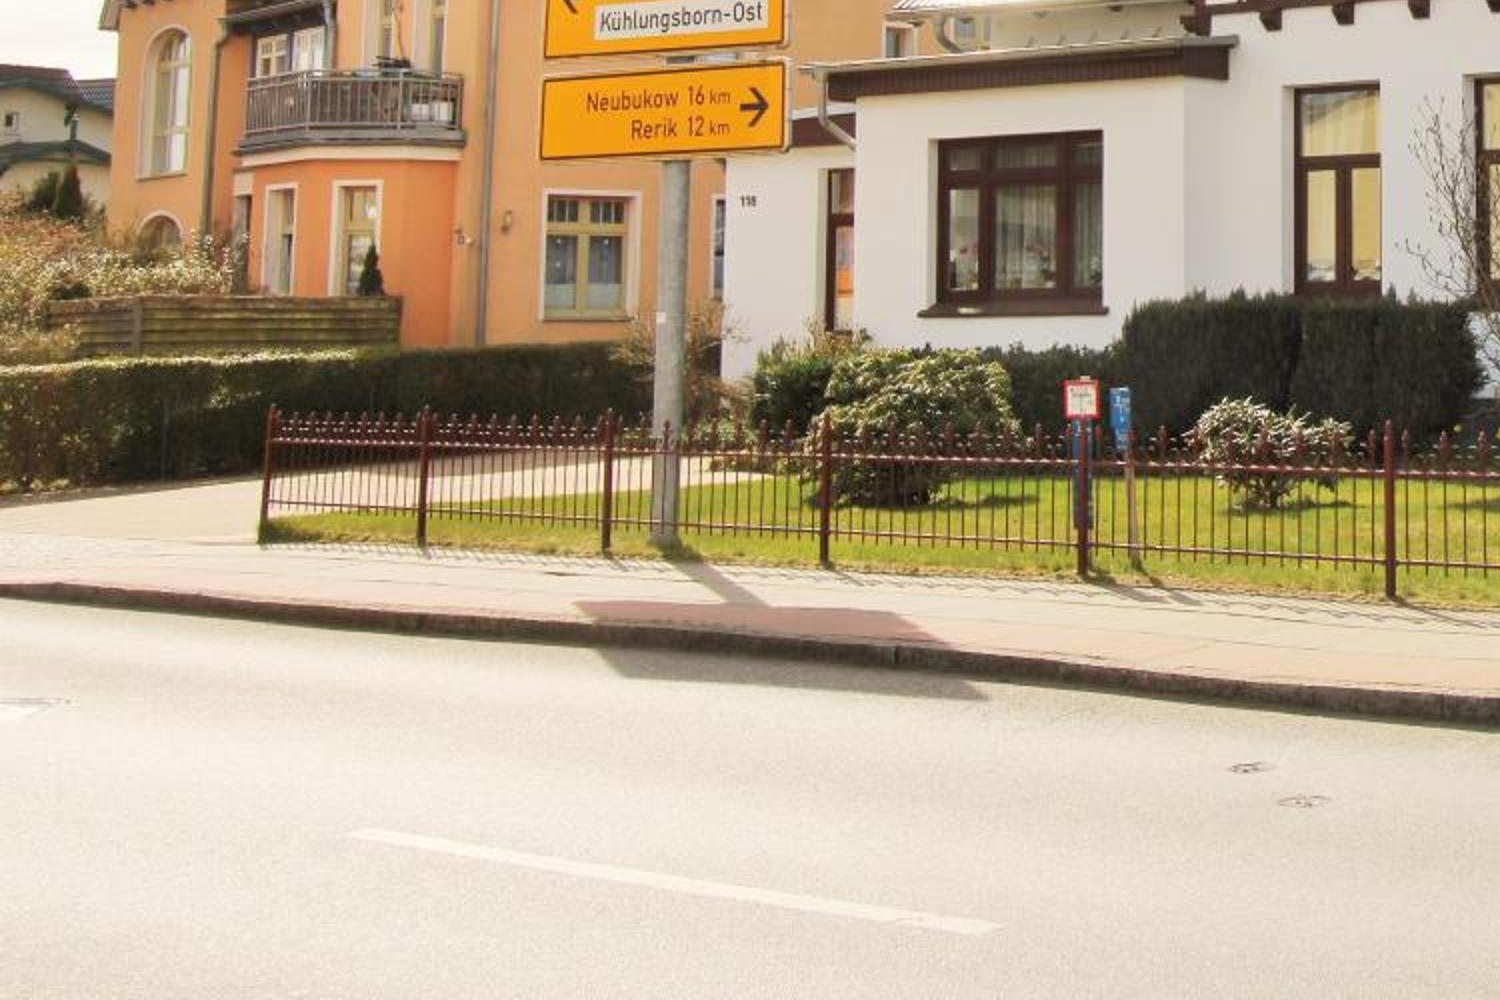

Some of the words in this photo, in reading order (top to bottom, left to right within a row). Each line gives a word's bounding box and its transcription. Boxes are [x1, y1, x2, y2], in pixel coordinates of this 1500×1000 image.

[600, 1, 763, 33] Kühlungsborn-Ost
[586, 88, 679, 113] Neubukow
[688, 85, 705, 106] 16
[709, 89, 731, 105] km
[631, 117, 678, 140] Rerik
[688, 115, 705, 137] 12
[709, 120, 731, 135] km
